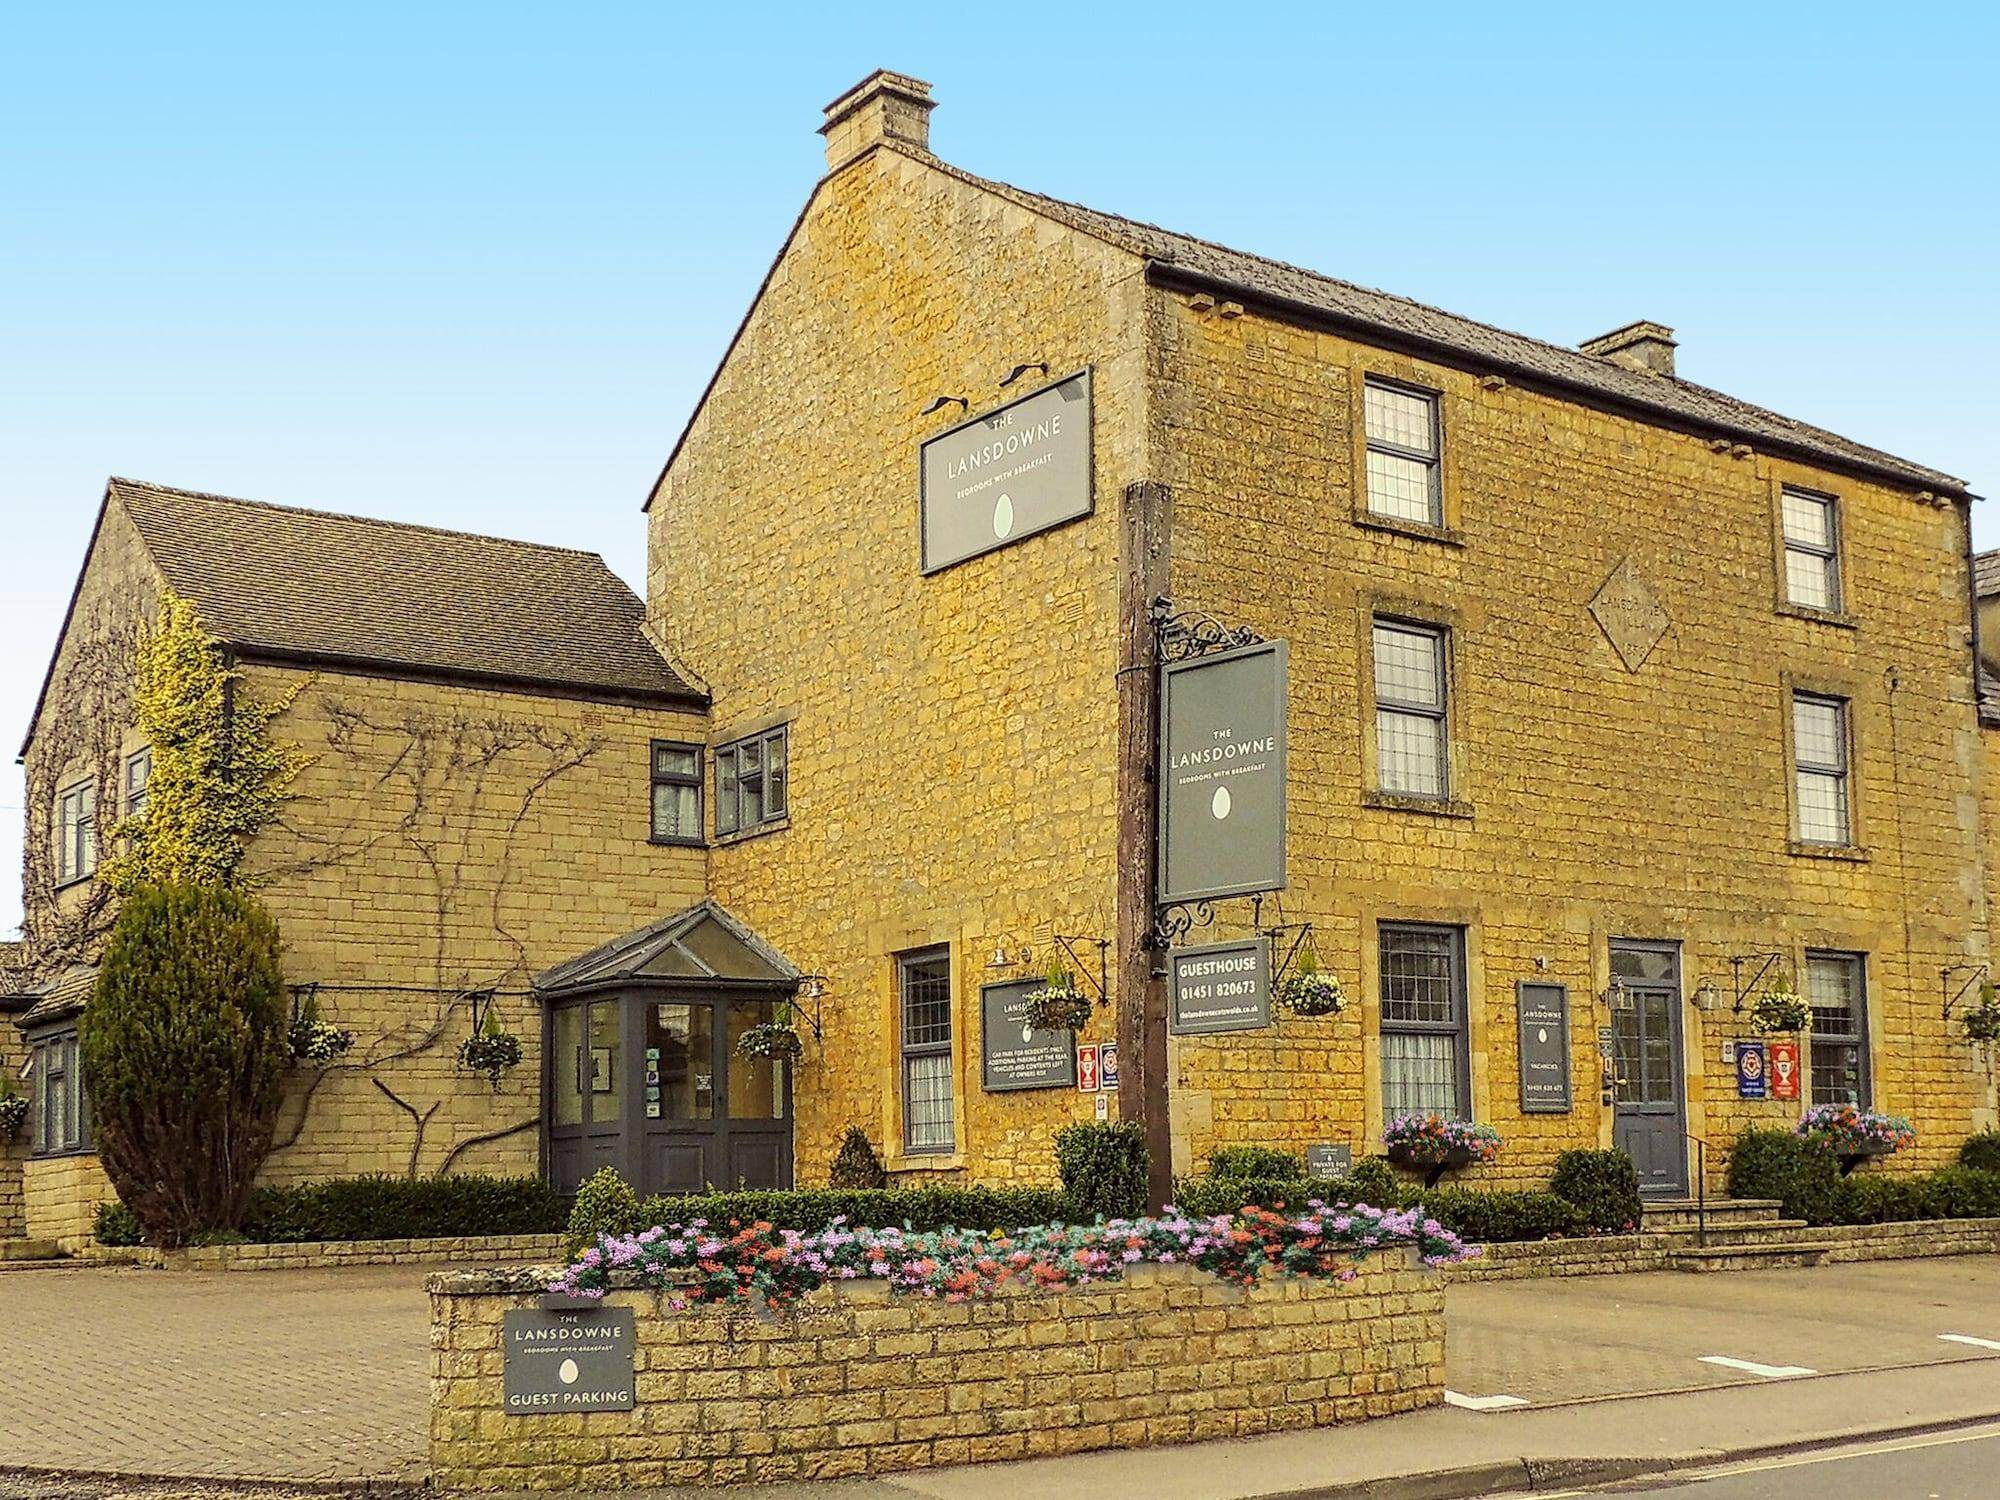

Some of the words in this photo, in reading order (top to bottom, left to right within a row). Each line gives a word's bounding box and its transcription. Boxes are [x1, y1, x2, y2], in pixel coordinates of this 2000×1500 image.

[993, 413, 1013, 431] THE
[948, 415, 1061, 479] LANSDOWNE
[957, 478, 992, 499] BEDROOMS
[994, 470, 1013, 482] WITH
[1014, 453, 1052, 475] BREAKFAST
[1213, 728, 1232, 739] THE
[1171, 737, 1275, 769] LANSDOWNE
[1179, 773, 1212, 785] BEDROOMS
[1213, 770, 1230, 778] WITH
[1231, 763, 1266, 775] BREAKFAST
[1179, 957, 1257, 978] GUESTHOUSE
[1181, 984, 1212, 1000] 01451
[1216, 980, 1256, 997] 820673
[560, 1315, 578, 1323] THE
[515, 1327, 621, 1341] LANSDOWNE
[510, 1393, 558, 1406] GUEST
[563, 1391, 628, 1404] PARKING
